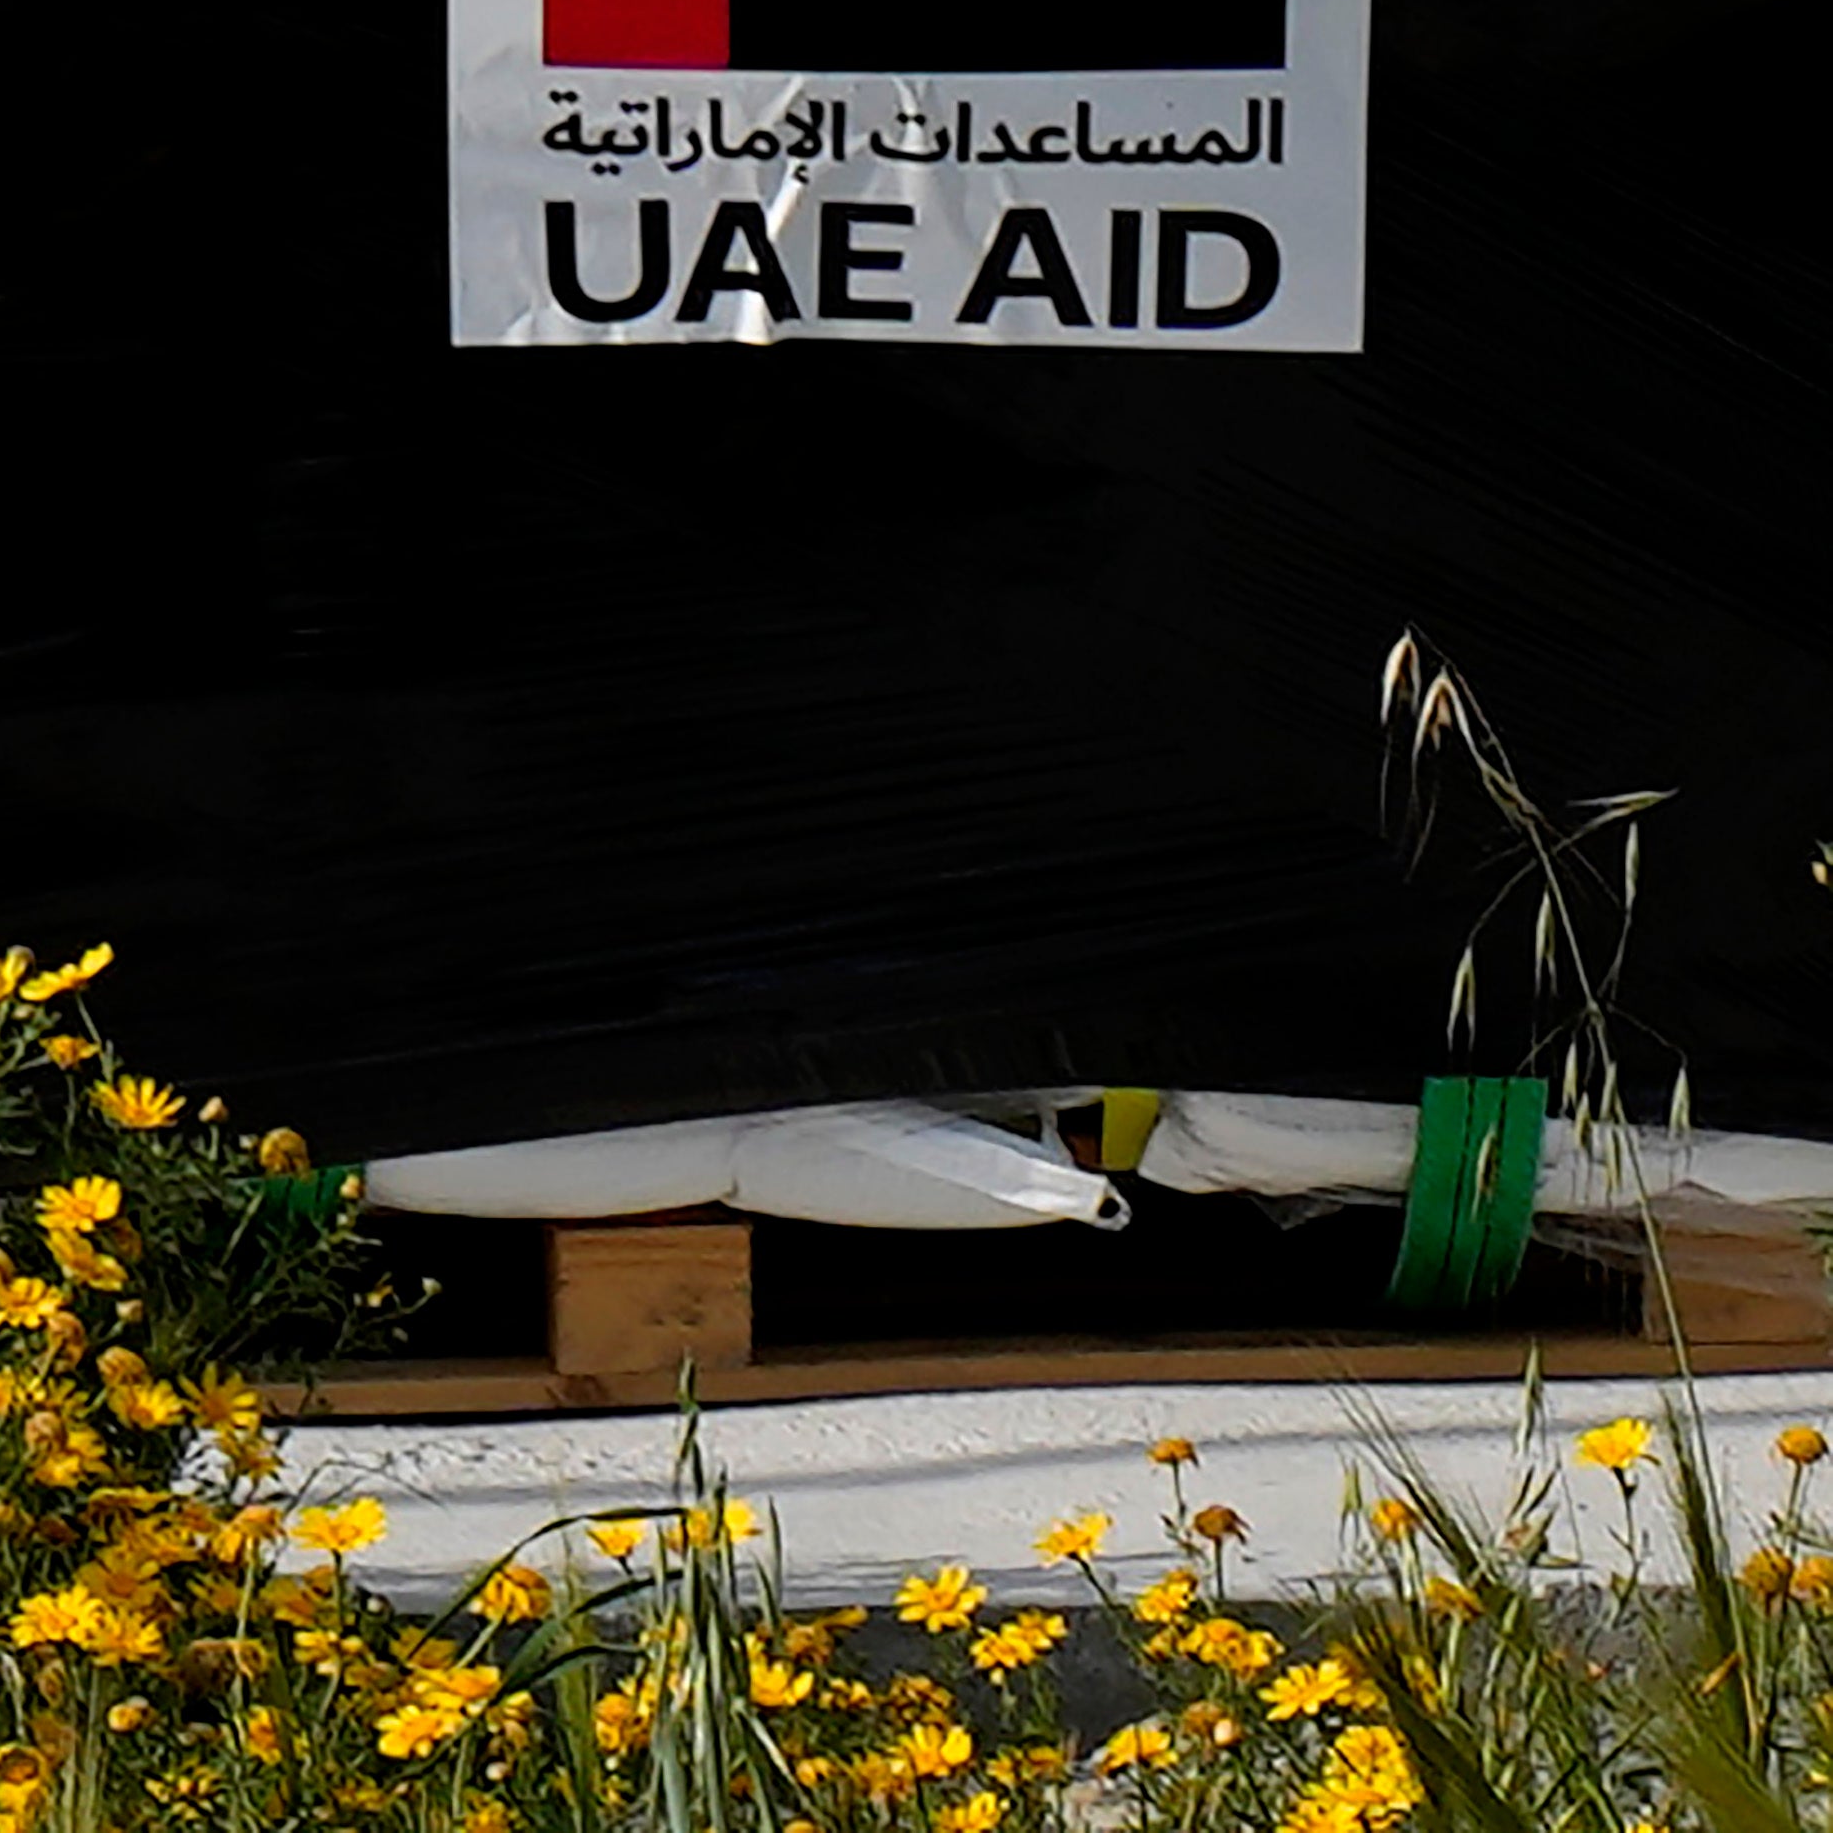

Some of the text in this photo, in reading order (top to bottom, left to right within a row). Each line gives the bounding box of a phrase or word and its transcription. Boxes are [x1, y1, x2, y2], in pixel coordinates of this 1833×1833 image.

[542, 90, 1284, 184] المساعدات الإماراتية
[544, 199, 1281, 330] UAE AID
